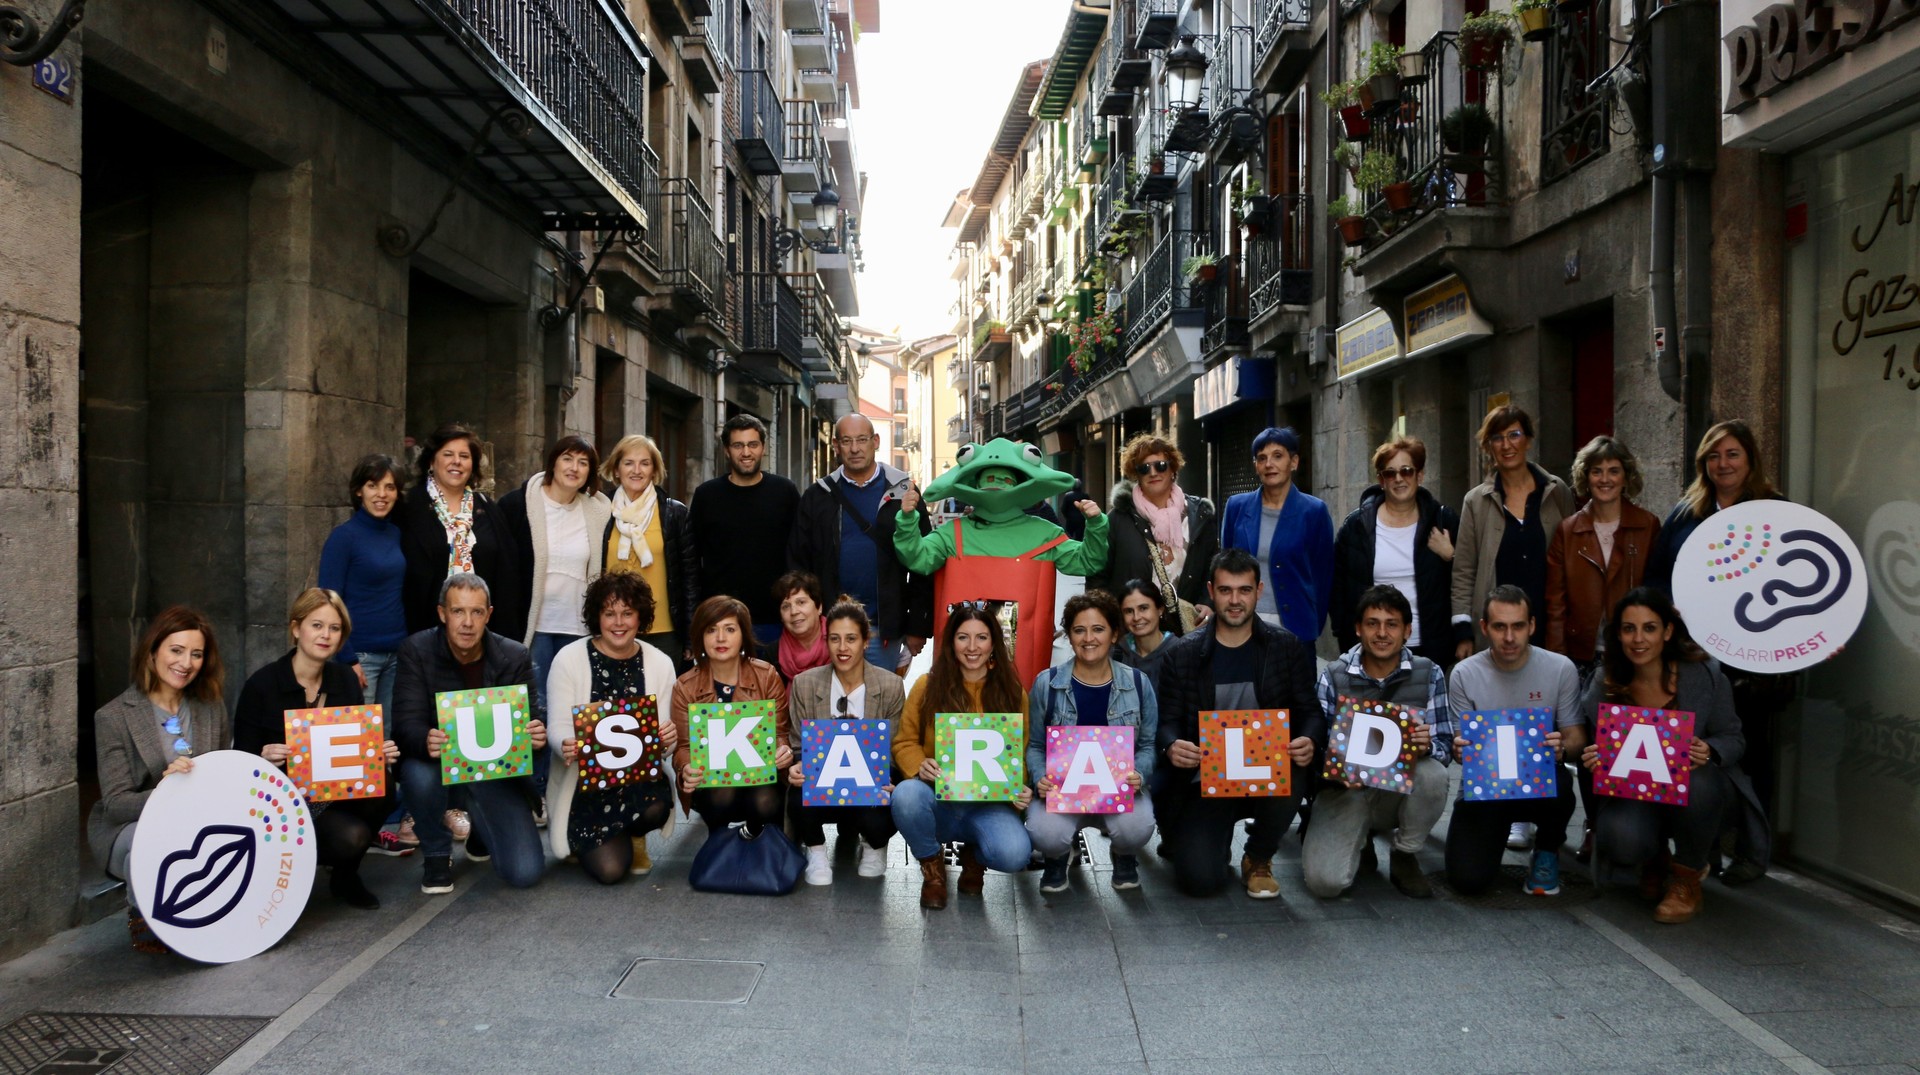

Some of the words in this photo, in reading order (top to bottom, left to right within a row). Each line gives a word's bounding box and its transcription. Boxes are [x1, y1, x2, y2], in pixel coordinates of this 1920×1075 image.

[41, 57, 72, 96] 52
[1705, 631, 1828, 662] BELARRIPREST
[310, 723, 364, 782] E
[455, 702, 513, 762] U
[595, 714, 644, 770] S
[707, 716, 766, 770] K
[815, 734, 876, 788] A
[954, 729, 1009, 782] R
[1060, 741, 1119, 794] A
[1225, 728, 1271, 780] L
[1345, 712, 1402, 769] D
[1496, 725, 1518, 780] I
[1608, 723, 1673, 785] A
[257, 852, 293, 928] AHOBIZI
